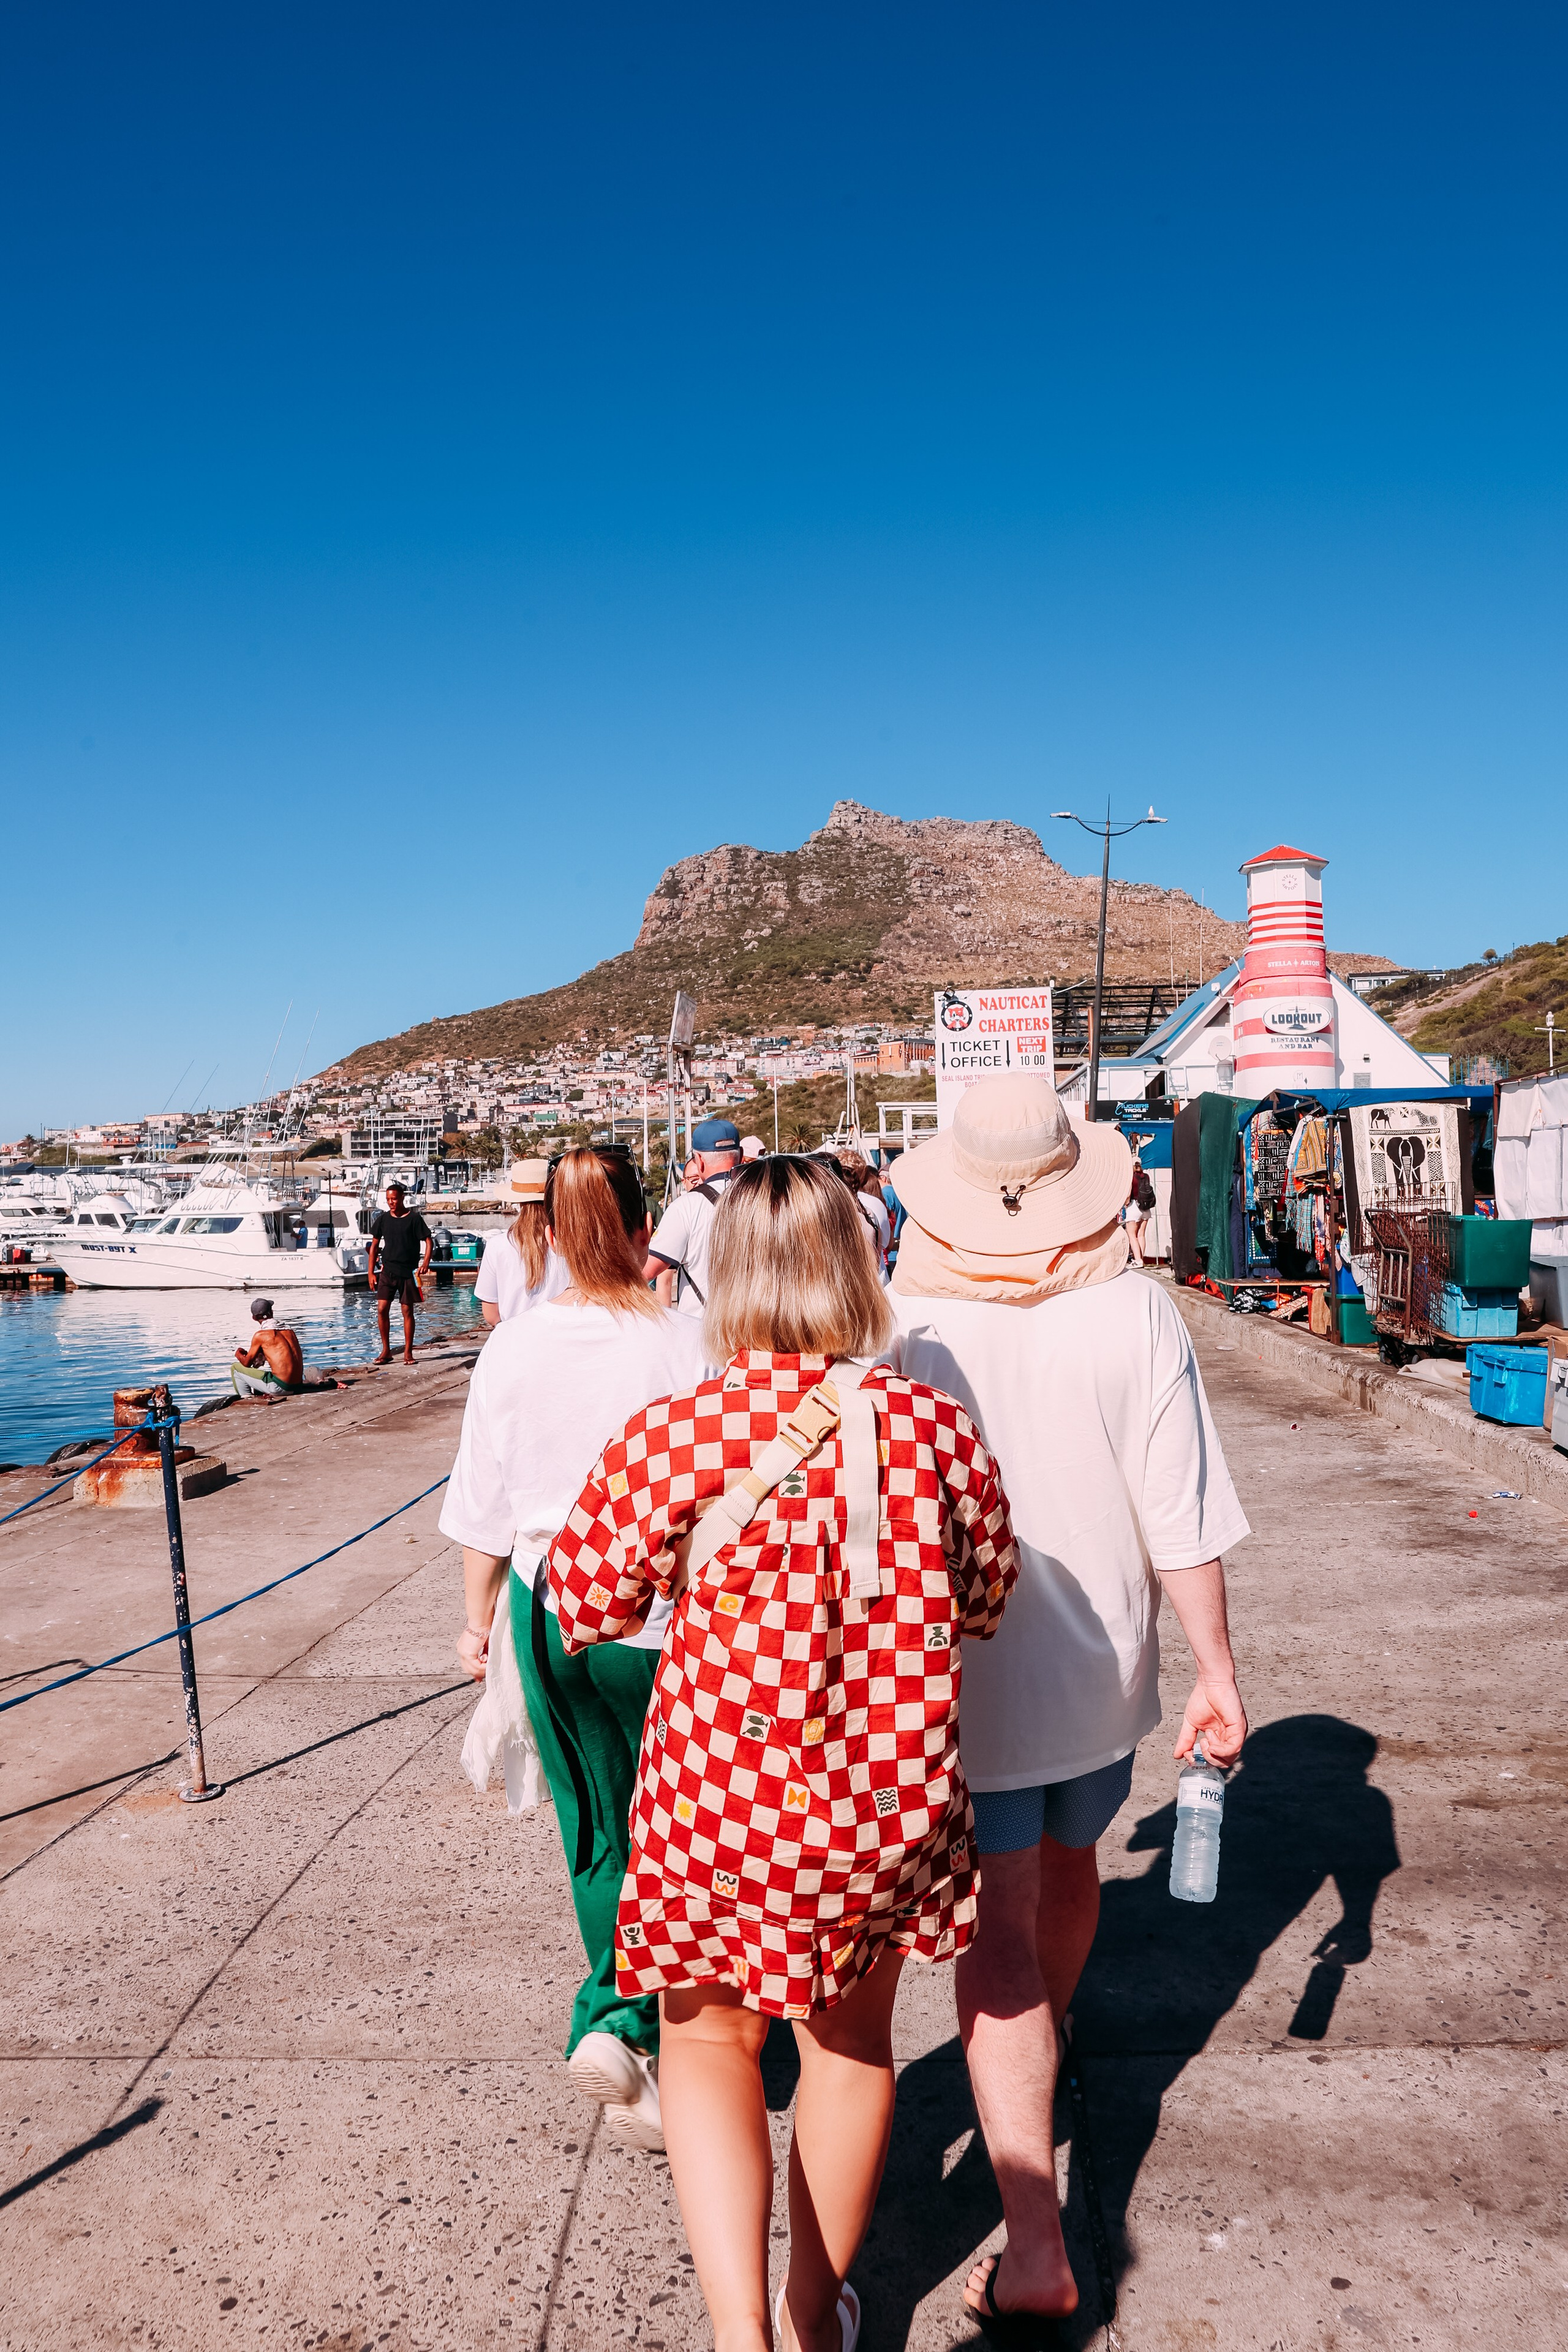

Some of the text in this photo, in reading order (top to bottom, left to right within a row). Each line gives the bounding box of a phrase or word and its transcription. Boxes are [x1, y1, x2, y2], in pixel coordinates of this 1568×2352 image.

[979, 995, 1047, 1011] NAUTICAT
[979, 1017, 1050, 1033] CHARTERS
[1272, 1013, 1322, 1025] LOOKOUT
[950, 1040, 1000, 1052] TICKET
[951, 1056, 1002, 1068] OFFICE
[1020, 1055, 1045, 1066] 10 00
